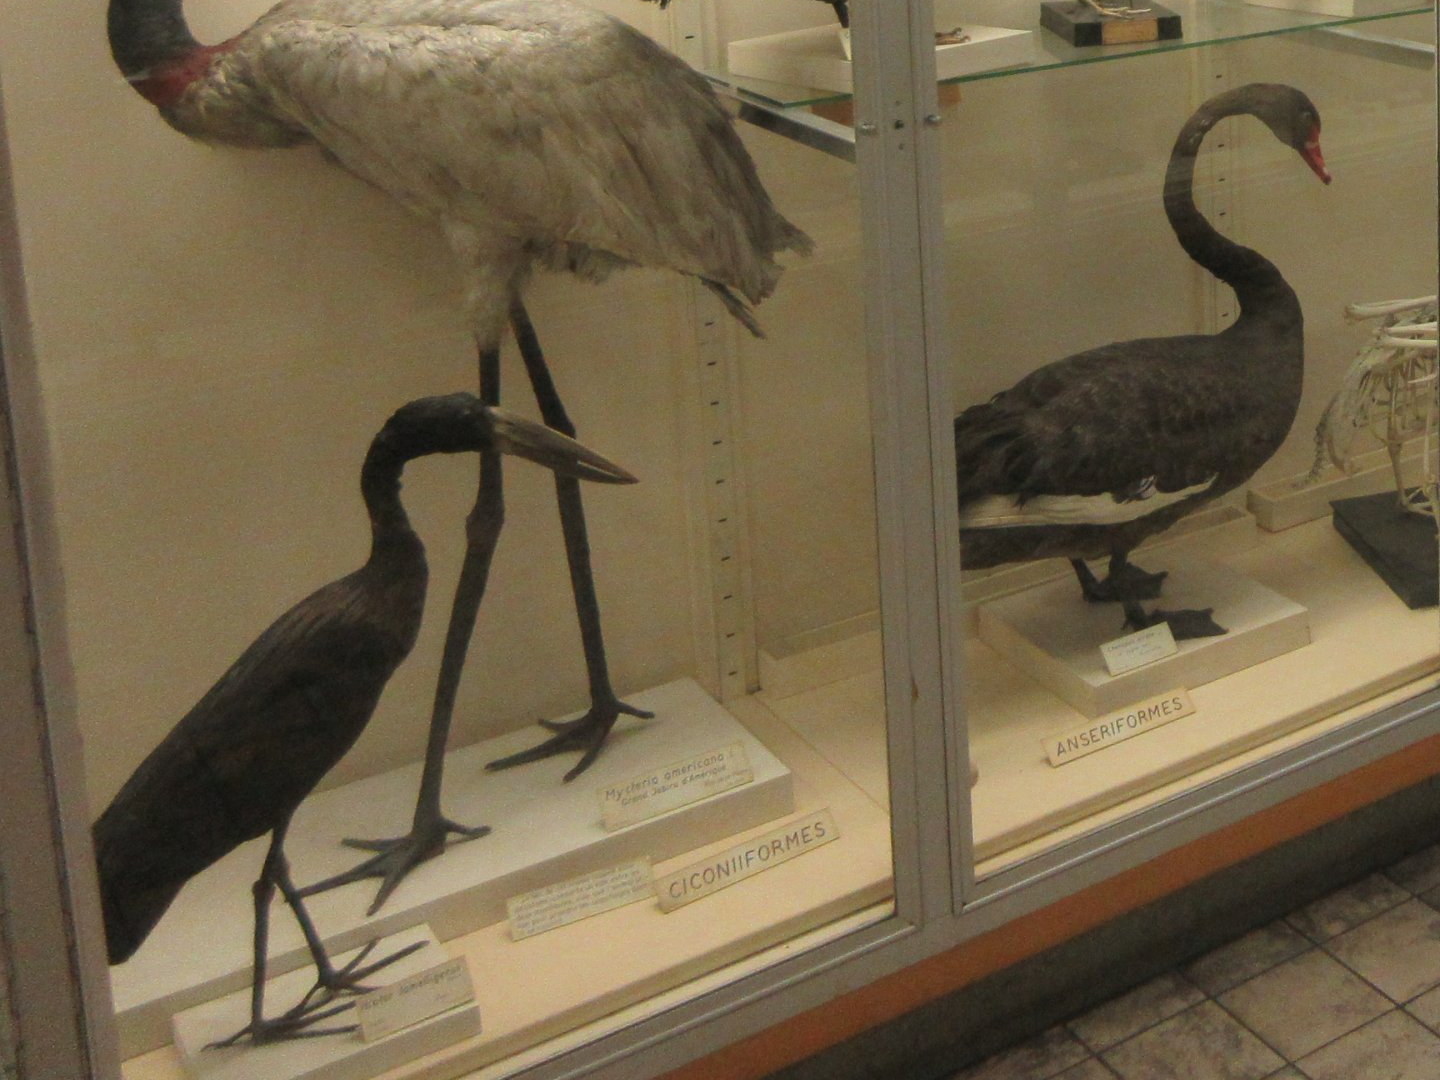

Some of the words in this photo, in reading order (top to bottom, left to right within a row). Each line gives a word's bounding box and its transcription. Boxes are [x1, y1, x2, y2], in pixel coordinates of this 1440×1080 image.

[1057, 697, 1183, 756] ANSERIFORMES
[664, 753, 724, 780] americana
[668, 821, 826, 899] CICONIIFORMES
